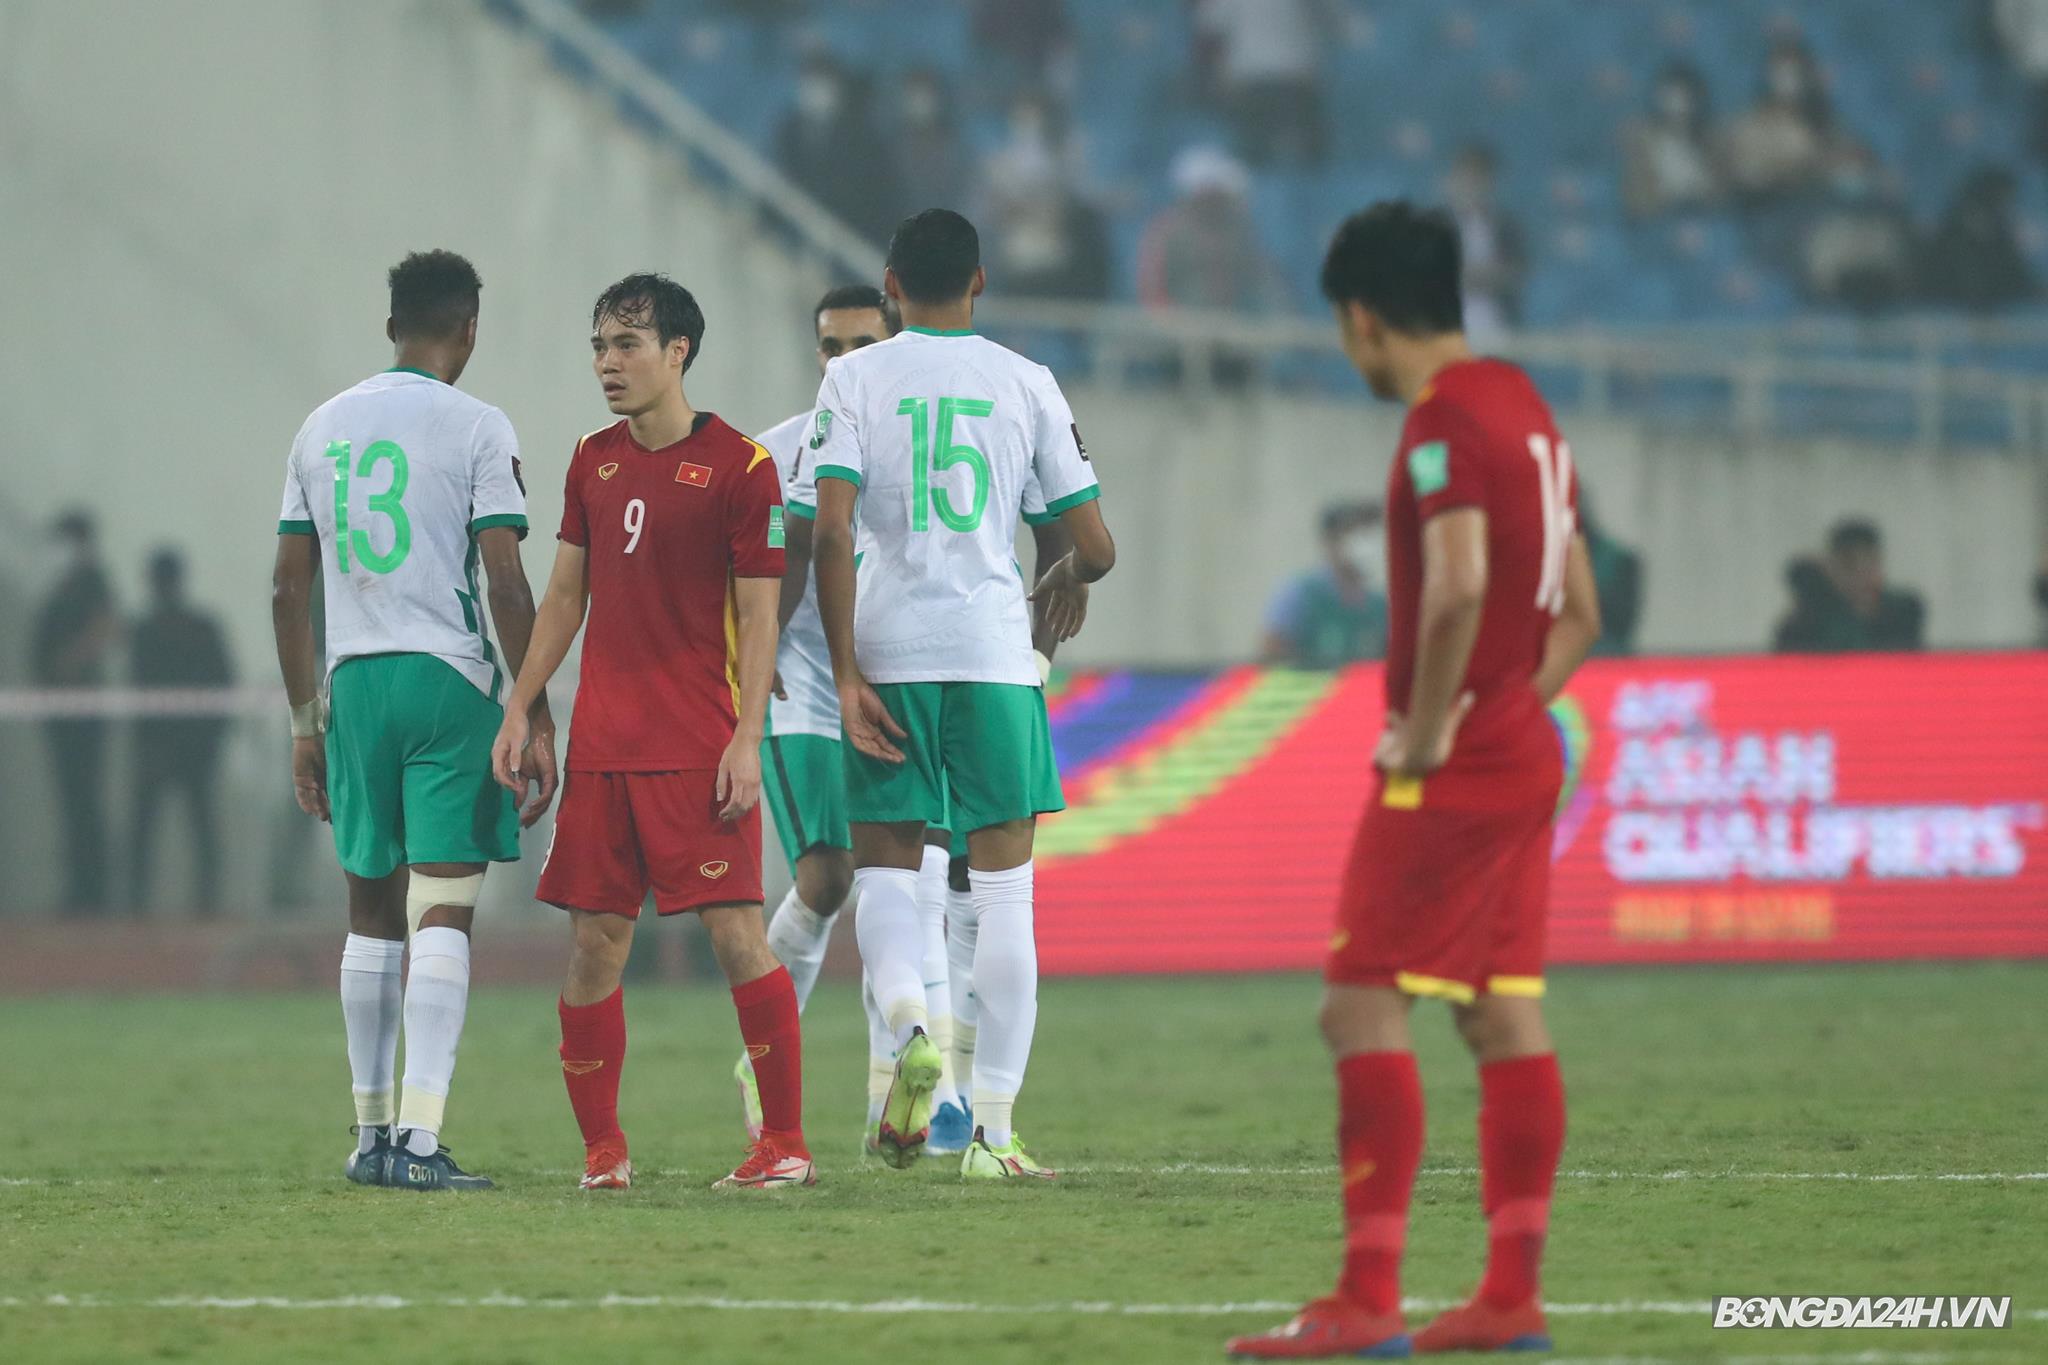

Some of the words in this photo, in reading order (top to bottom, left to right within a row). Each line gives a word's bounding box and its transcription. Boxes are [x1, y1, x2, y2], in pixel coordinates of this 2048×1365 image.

[322, 439, 411, 575] 13
[623, 498, 646, 554] 9
[896, 396, 995, 533] 15
